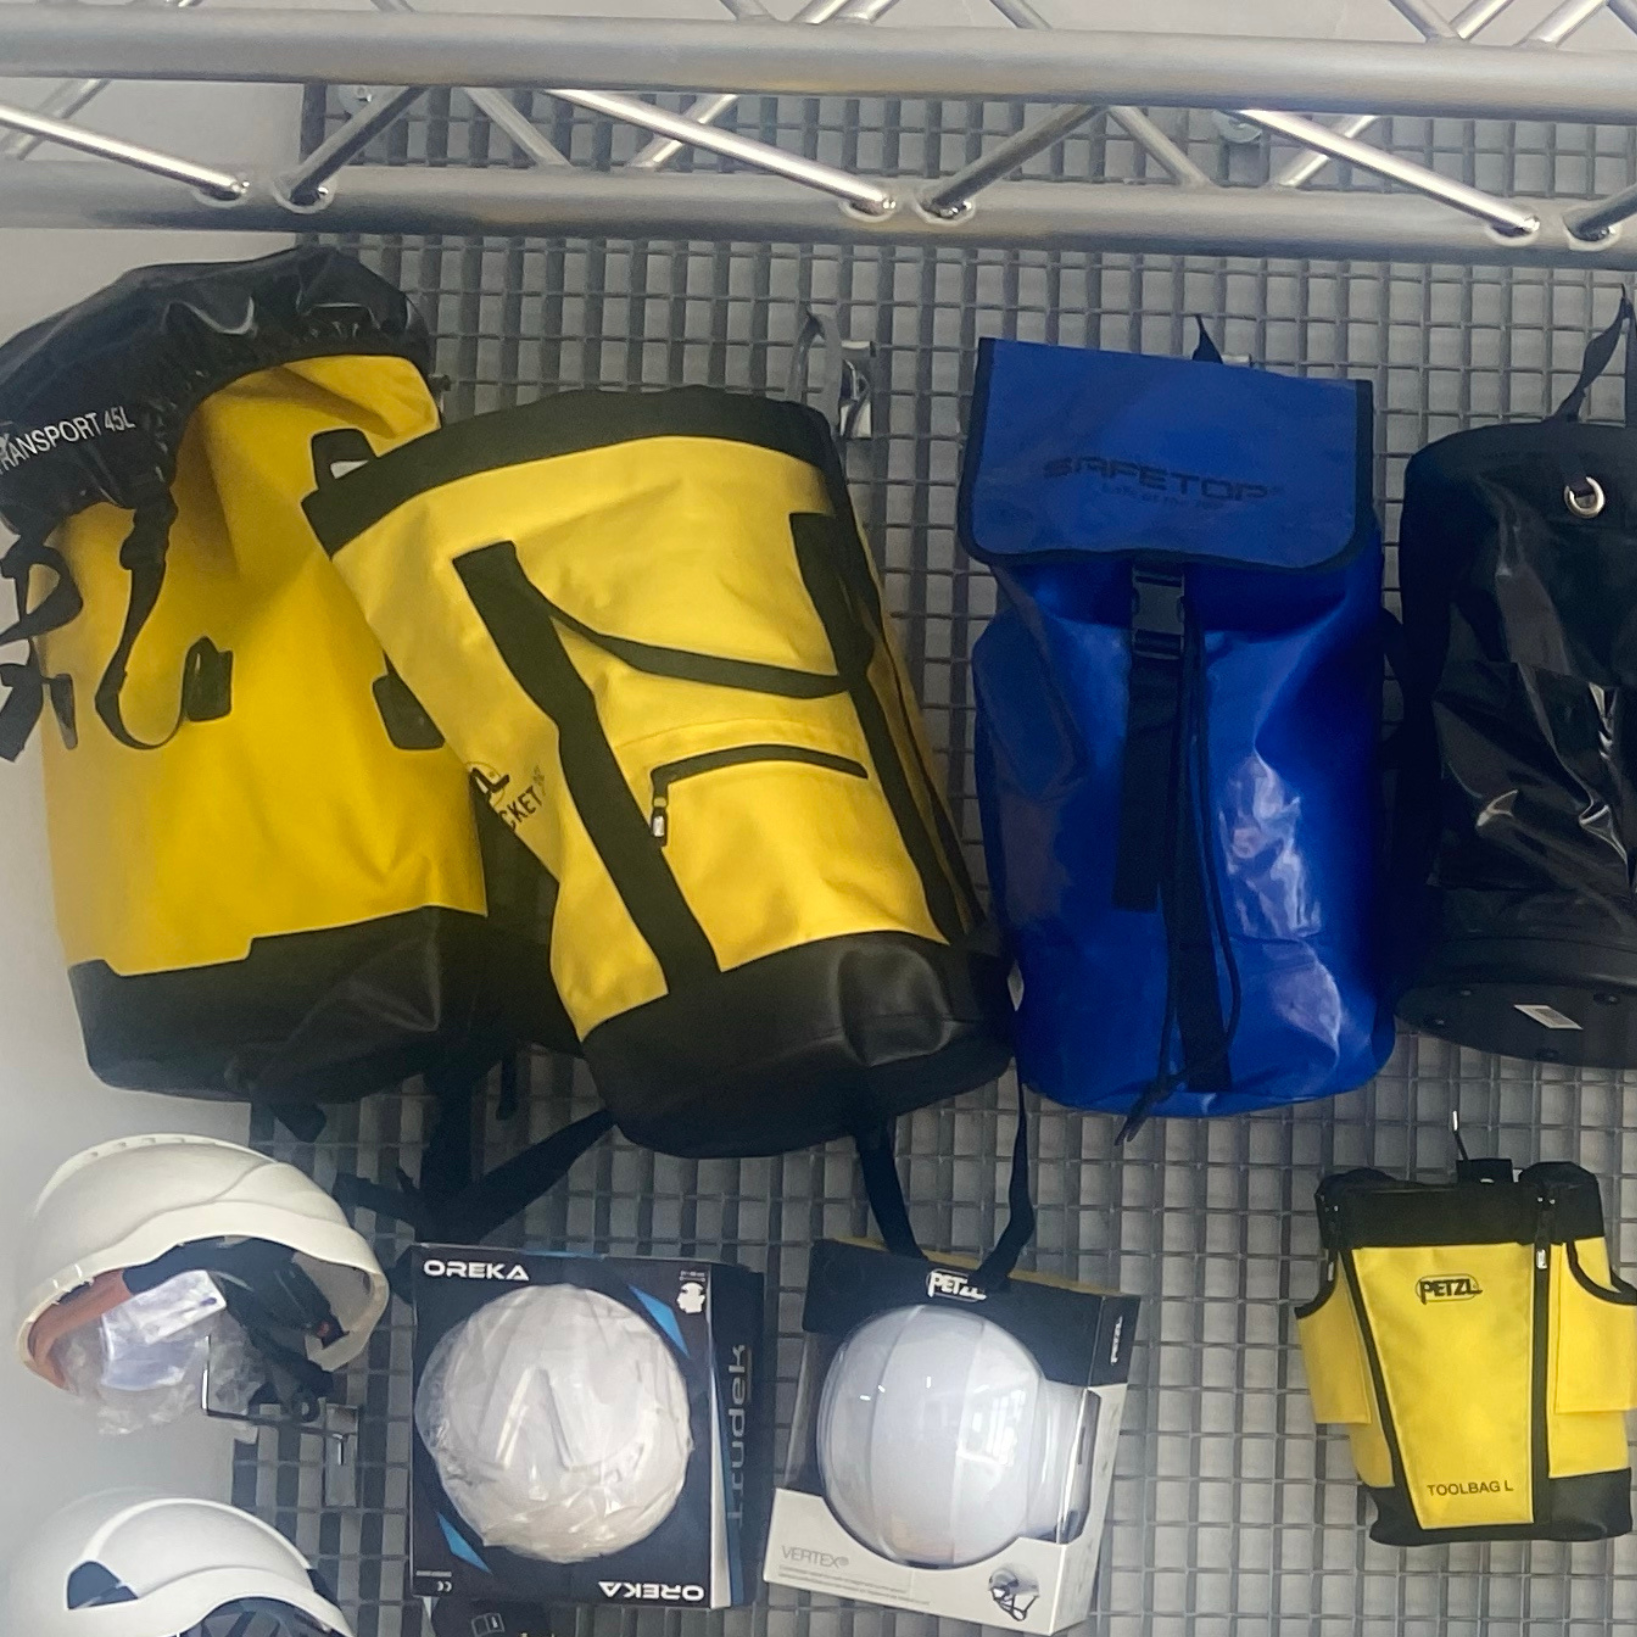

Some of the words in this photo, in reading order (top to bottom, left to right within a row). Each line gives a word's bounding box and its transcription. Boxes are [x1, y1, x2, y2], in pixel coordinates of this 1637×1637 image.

[0, 412, 101, 475] RANSPORT
[104, 406, 136, 432] 45L
[423, 1259, 530, 1282] OREKA
[1415, 1277, 1483, 1305] PETZL
[1428, 1481, 1500, 1496] TOOLBAG
[1504, 1480, 1513, 1491] L
[598, 1582, 705, 1602] OREKA
